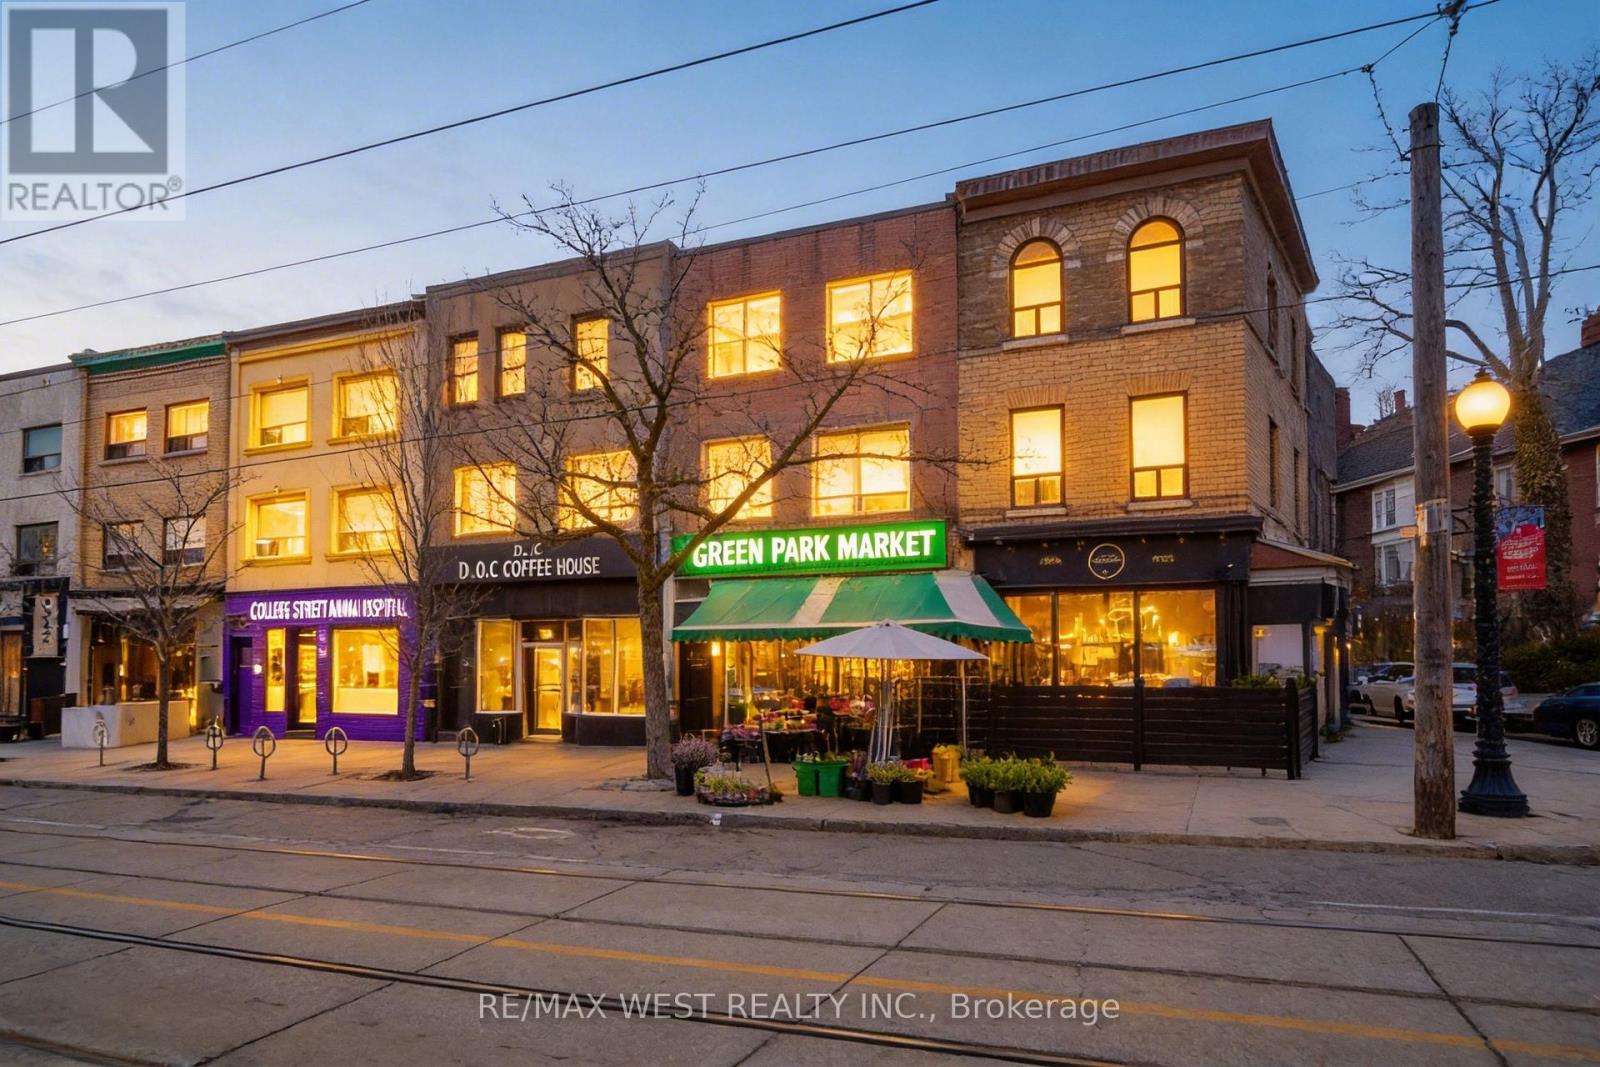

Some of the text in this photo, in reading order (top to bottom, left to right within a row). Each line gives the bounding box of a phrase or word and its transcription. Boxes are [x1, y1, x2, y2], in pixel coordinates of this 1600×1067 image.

[692, 529, 936, 567] GREEN PARK MARKET
[459, 557, 600, 579] D.O.C COFFEE HOUSE
